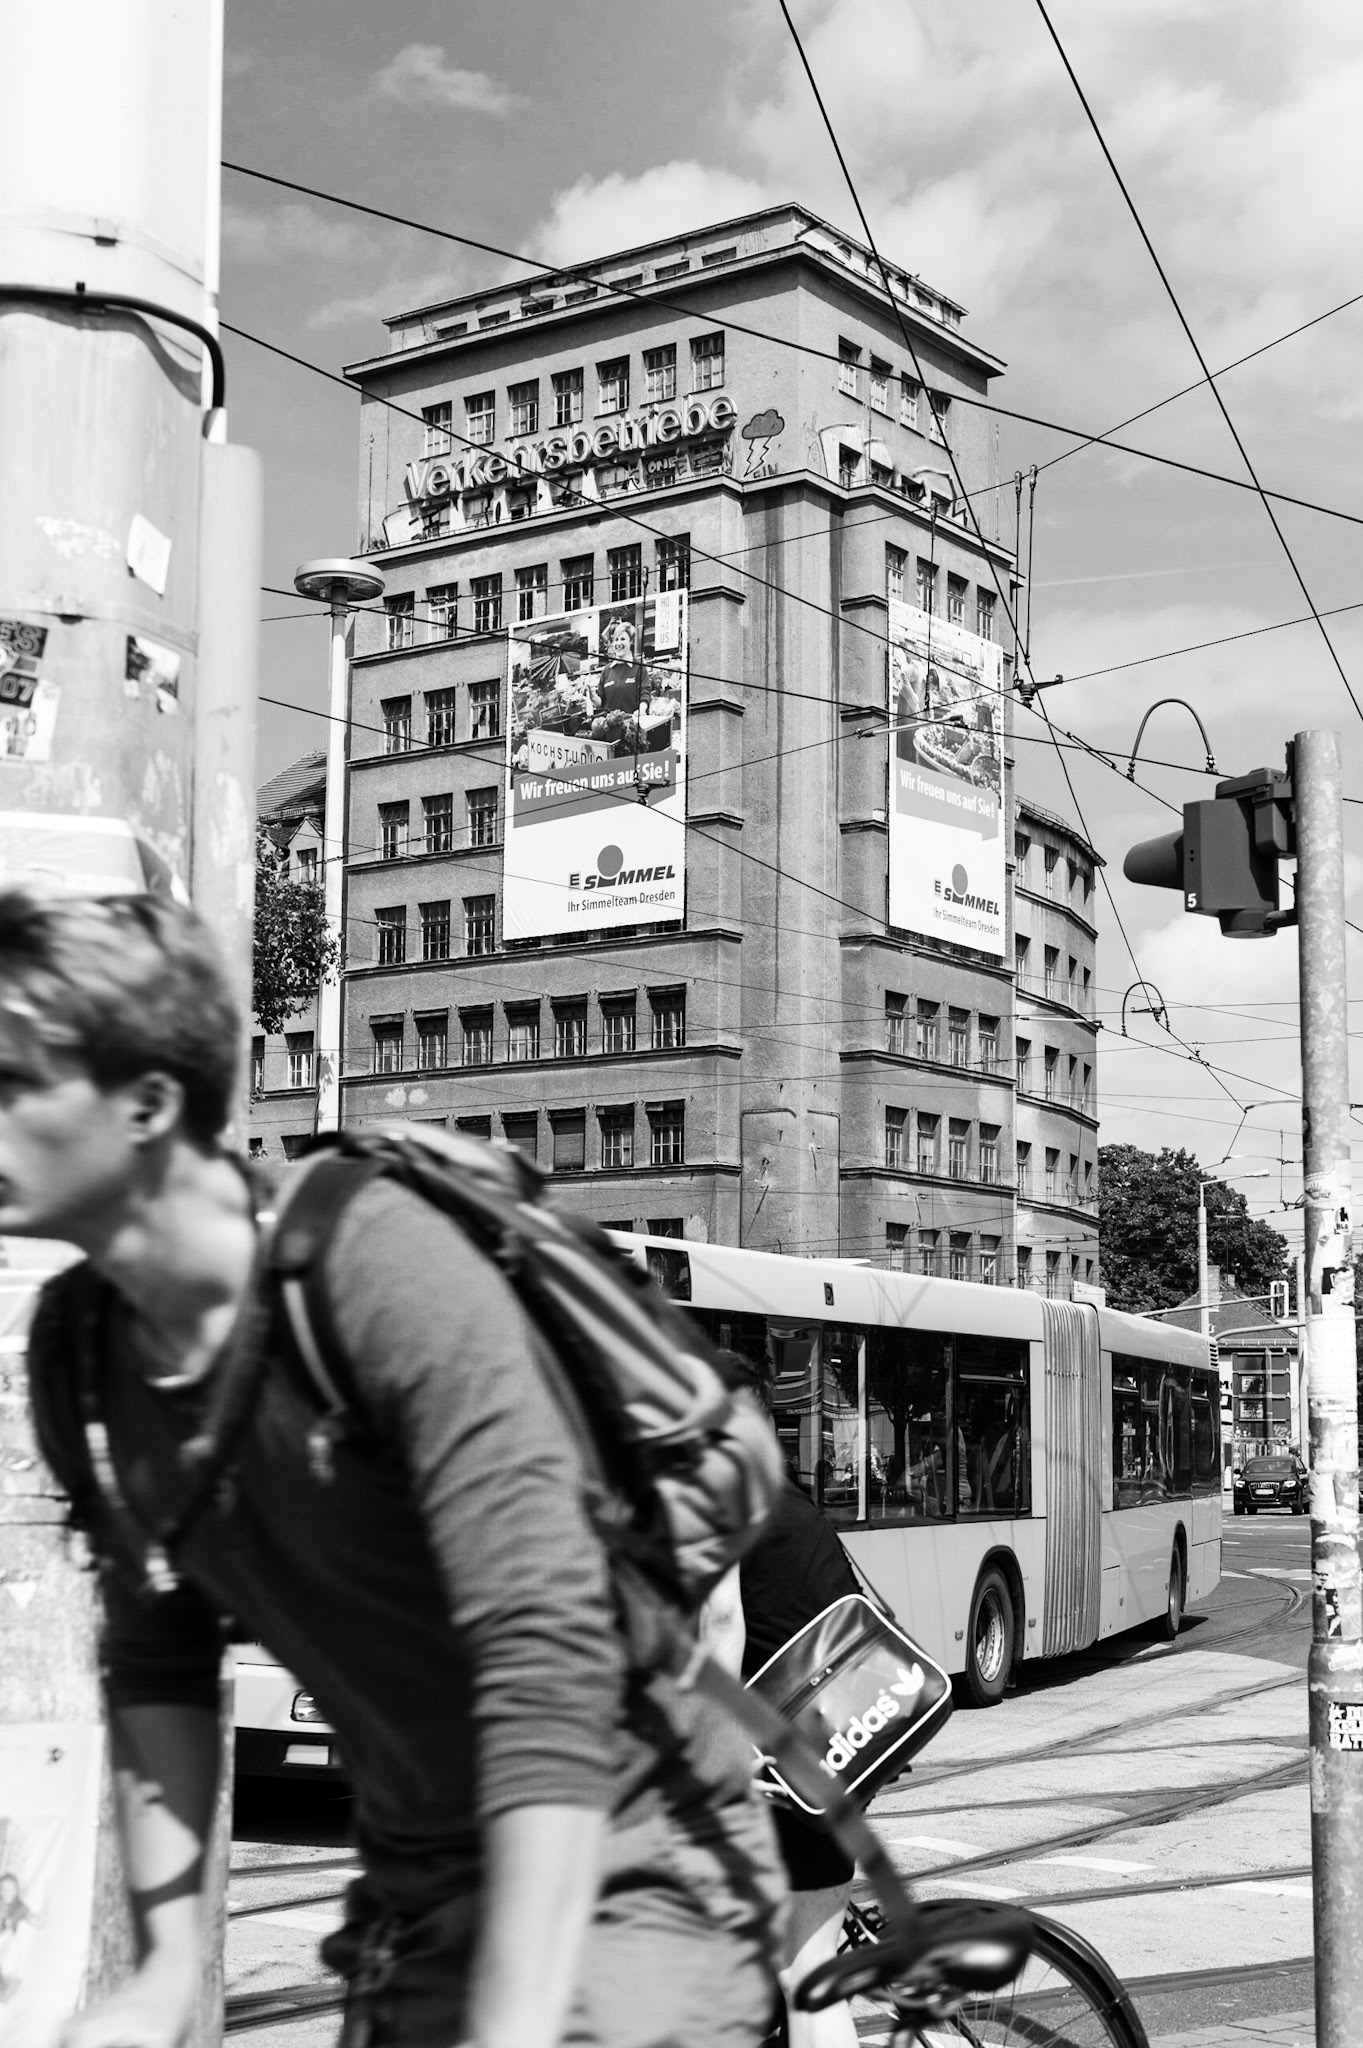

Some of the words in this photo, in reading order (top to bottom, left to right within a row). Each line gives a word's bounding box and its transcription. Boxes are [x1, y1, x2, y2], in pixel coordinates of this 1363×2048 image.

[405, 396, 738, 499] Verkehrsbetriebe
[520, 780, 543, 800] Wir
[545, 777, 588, 797] freuen
[591, 773, 615, 789] uns
[900, 769, 916, 791] Wir
[916, 775, 945, 802] freuen
[946, 790, 961, 807] uns
[962, 795, 977, 812] auf
[568, 901, 580, 912] Ihr
[582, 895, 637, 911] Simmelteam
[639, 890, 676, 904] Dresden
[1187, 893, 1197, 908] 5
[978, 919, 1000, 936] Dresden
